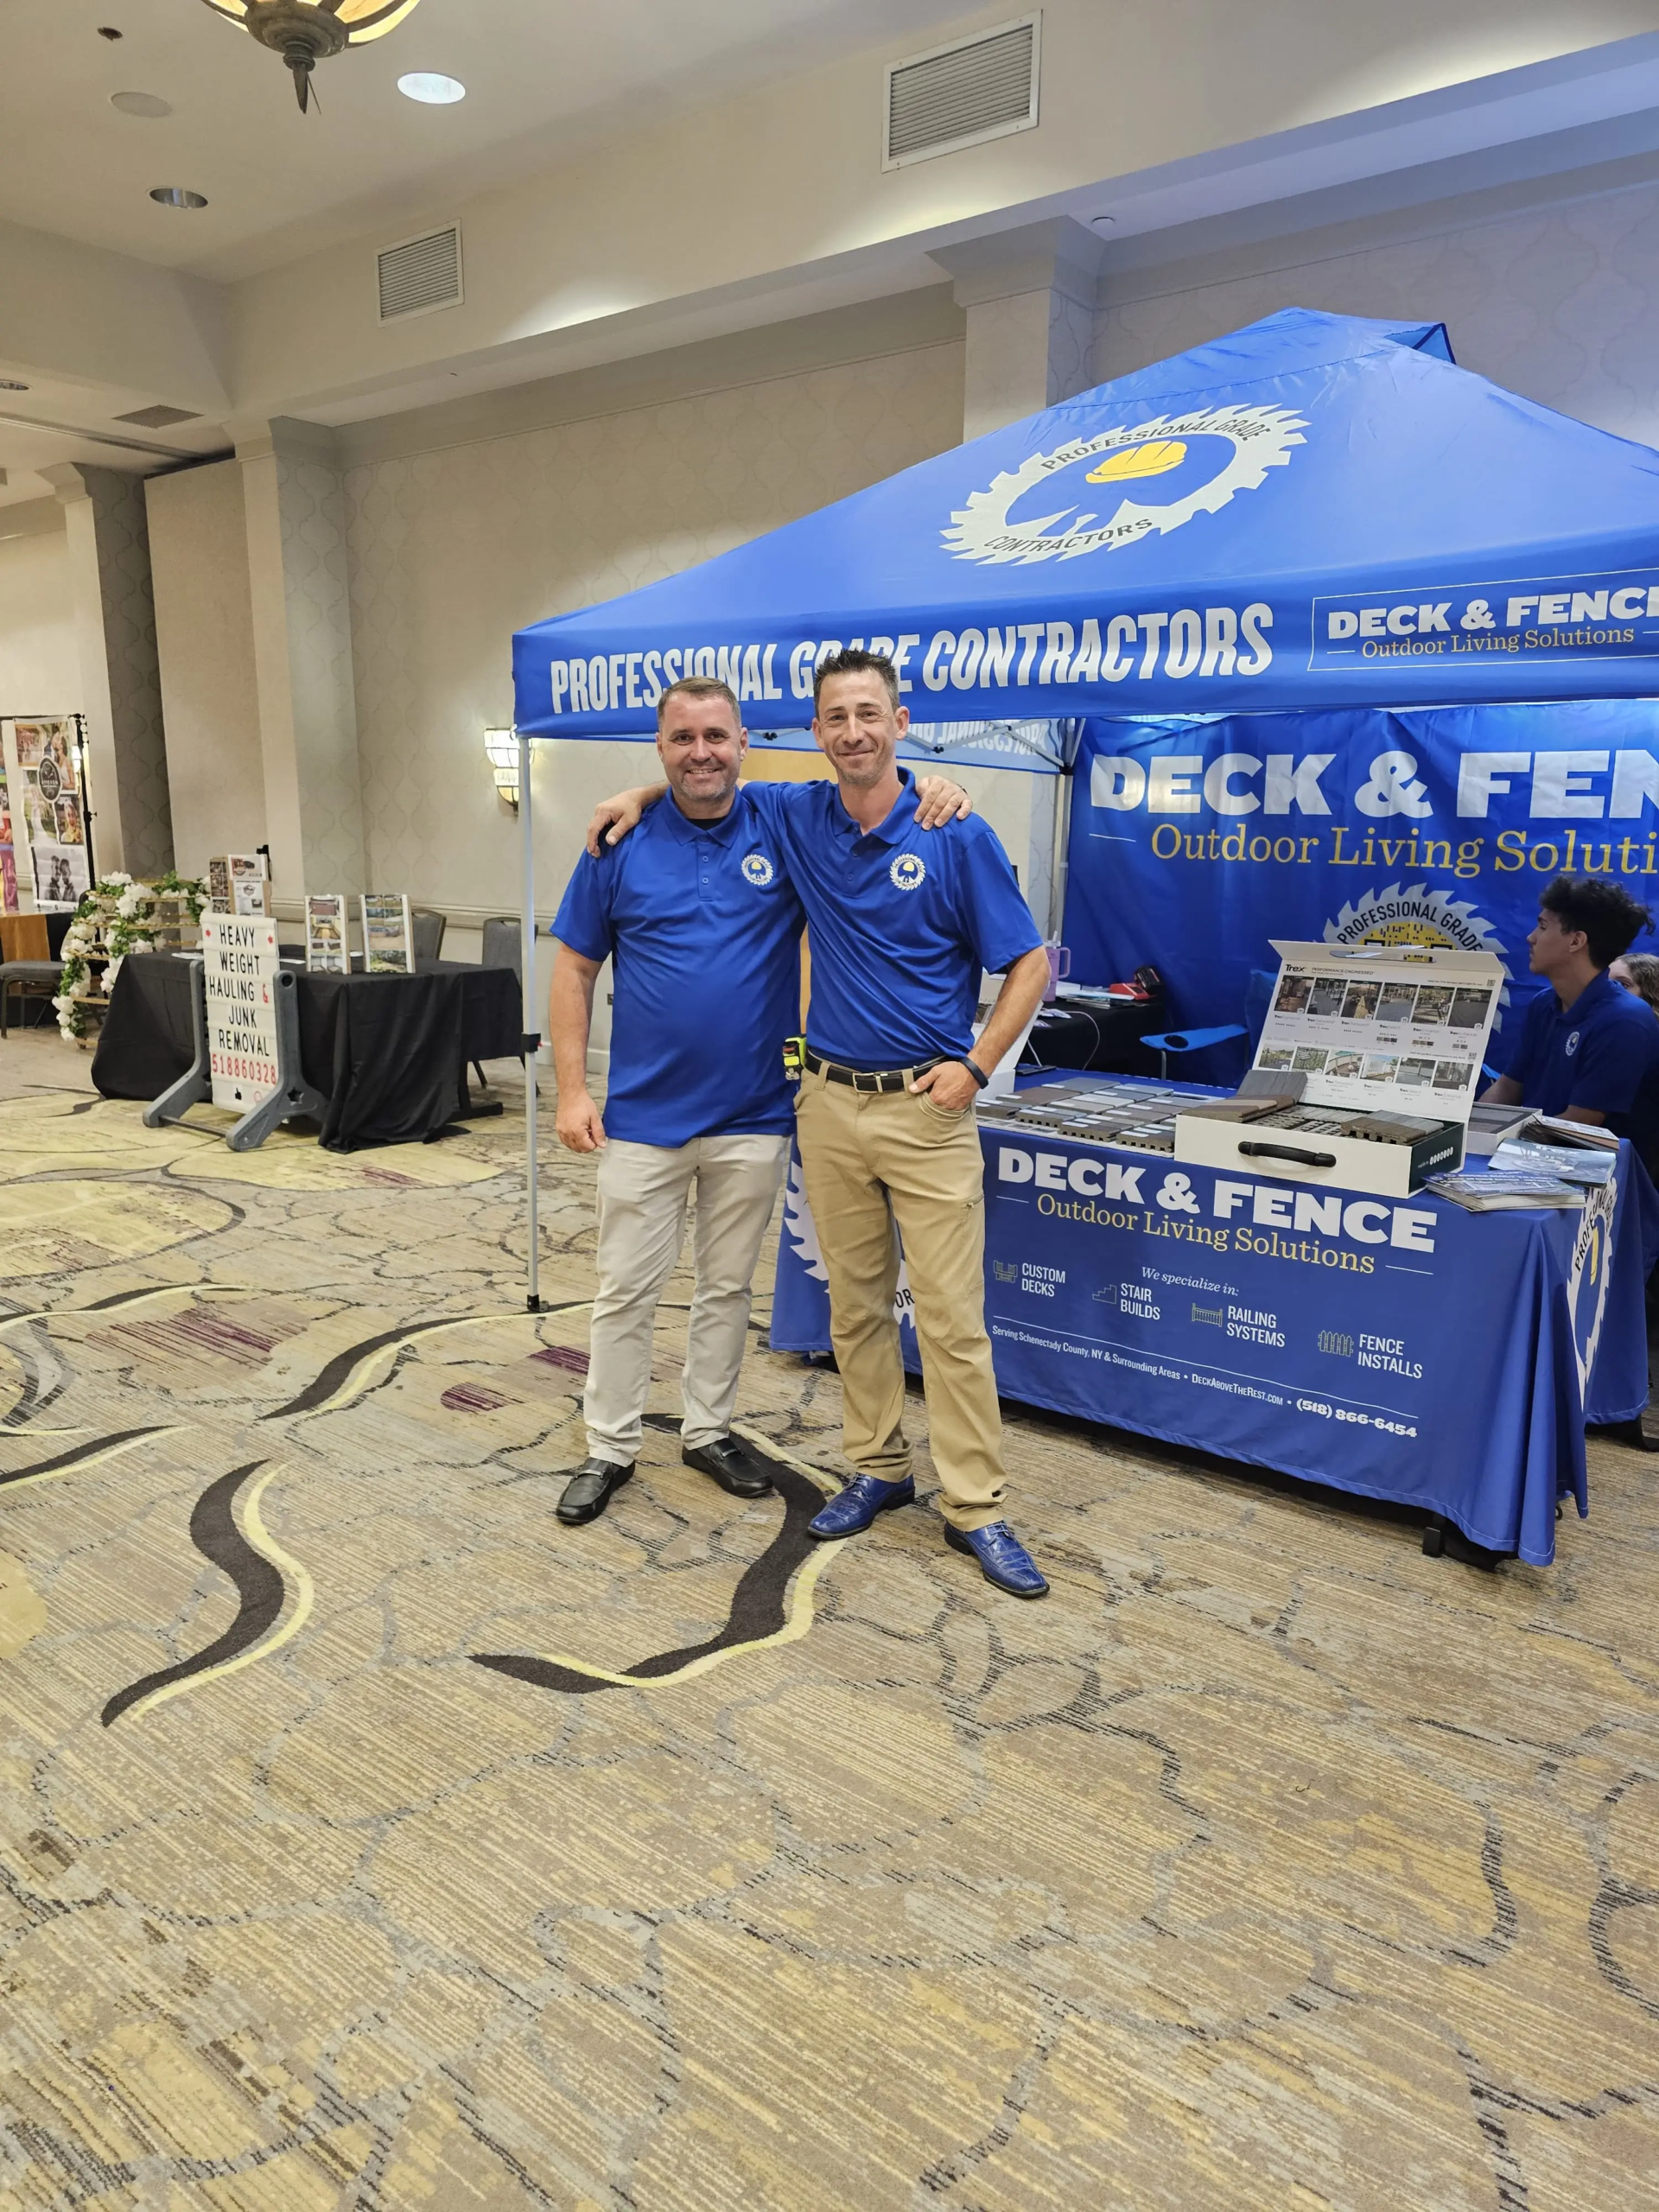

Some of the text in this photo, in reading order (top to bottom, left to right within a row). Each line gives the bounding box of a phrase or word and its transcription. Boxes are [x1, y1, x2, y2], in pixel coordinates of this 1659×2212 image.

[1039, 419, 1272, 470] PROFESSIONAL GRADE
[983, 518, 1153, 552] CONTRACTORS
[1328, 602, 1452, 639] DECK
[1459, 599, 1497, 631] &
[789, 633, 920, 700] GRE
[922, 602, 1274, 692] CONTRACTORS
[1362, 626, 1635, 658] Outdoor Living Solutions
[1090, 753, 1338, 816] DECK
[1354, 750, 1434, 818] &
[1151, 823, 1658, 878] Outdoor Living Soluti
[219, 924, 255, 948] HEAVY
[1337, 901, 1484, 951] PROFESSIONAL GRADE
[219, 950, 259, 976] WEIGHT
[1285, 963, 1306, 973] Trex
[209, 976, 255, 1001] HAULING
[229, 1005, 257, 1029] JUNK
[219, 1028, 270, 1057] REMOVAL
[998, 1147, 1438, 1253] DECK & FENCE
[1037, 1193, 1375, 1274] Outdoor Living Solutions
[1021, 1262, 1066, 1284] CUSTOM
[1141, 1266, 1239, 1296] We specialize in:
[1021, 1278, 1055, 1297] DECKS
[1120, 1282, 1152, 1303] STAIR
[1120, 1300, 1161, 1320] BUILDS
[1227, 1305, 1277, 1329] RAILING
[1226, 1322, 1286, 1348] SYSTEMS
[1358, 1333, 1405, 1356] FENCE
[1357, 1351, 1423, 1379] INSTALLS
[992, 1325, 1018, 1341] Serving
[1019, 1332, 1061, 1352] Schenectady
[1063, 1342, 1090, 1358] County,
[1091, 1349, 1103, 1360] NY
[1103, 1351, 1112, 1363] &
[1112, 1353, 1158, 1376] Surrounding
[1159, 1365, 1181, 1380] Areas
[1296, 1398, 1332, 1419] (518)
[1335, 1408, 1417, 1438] 866-6454
